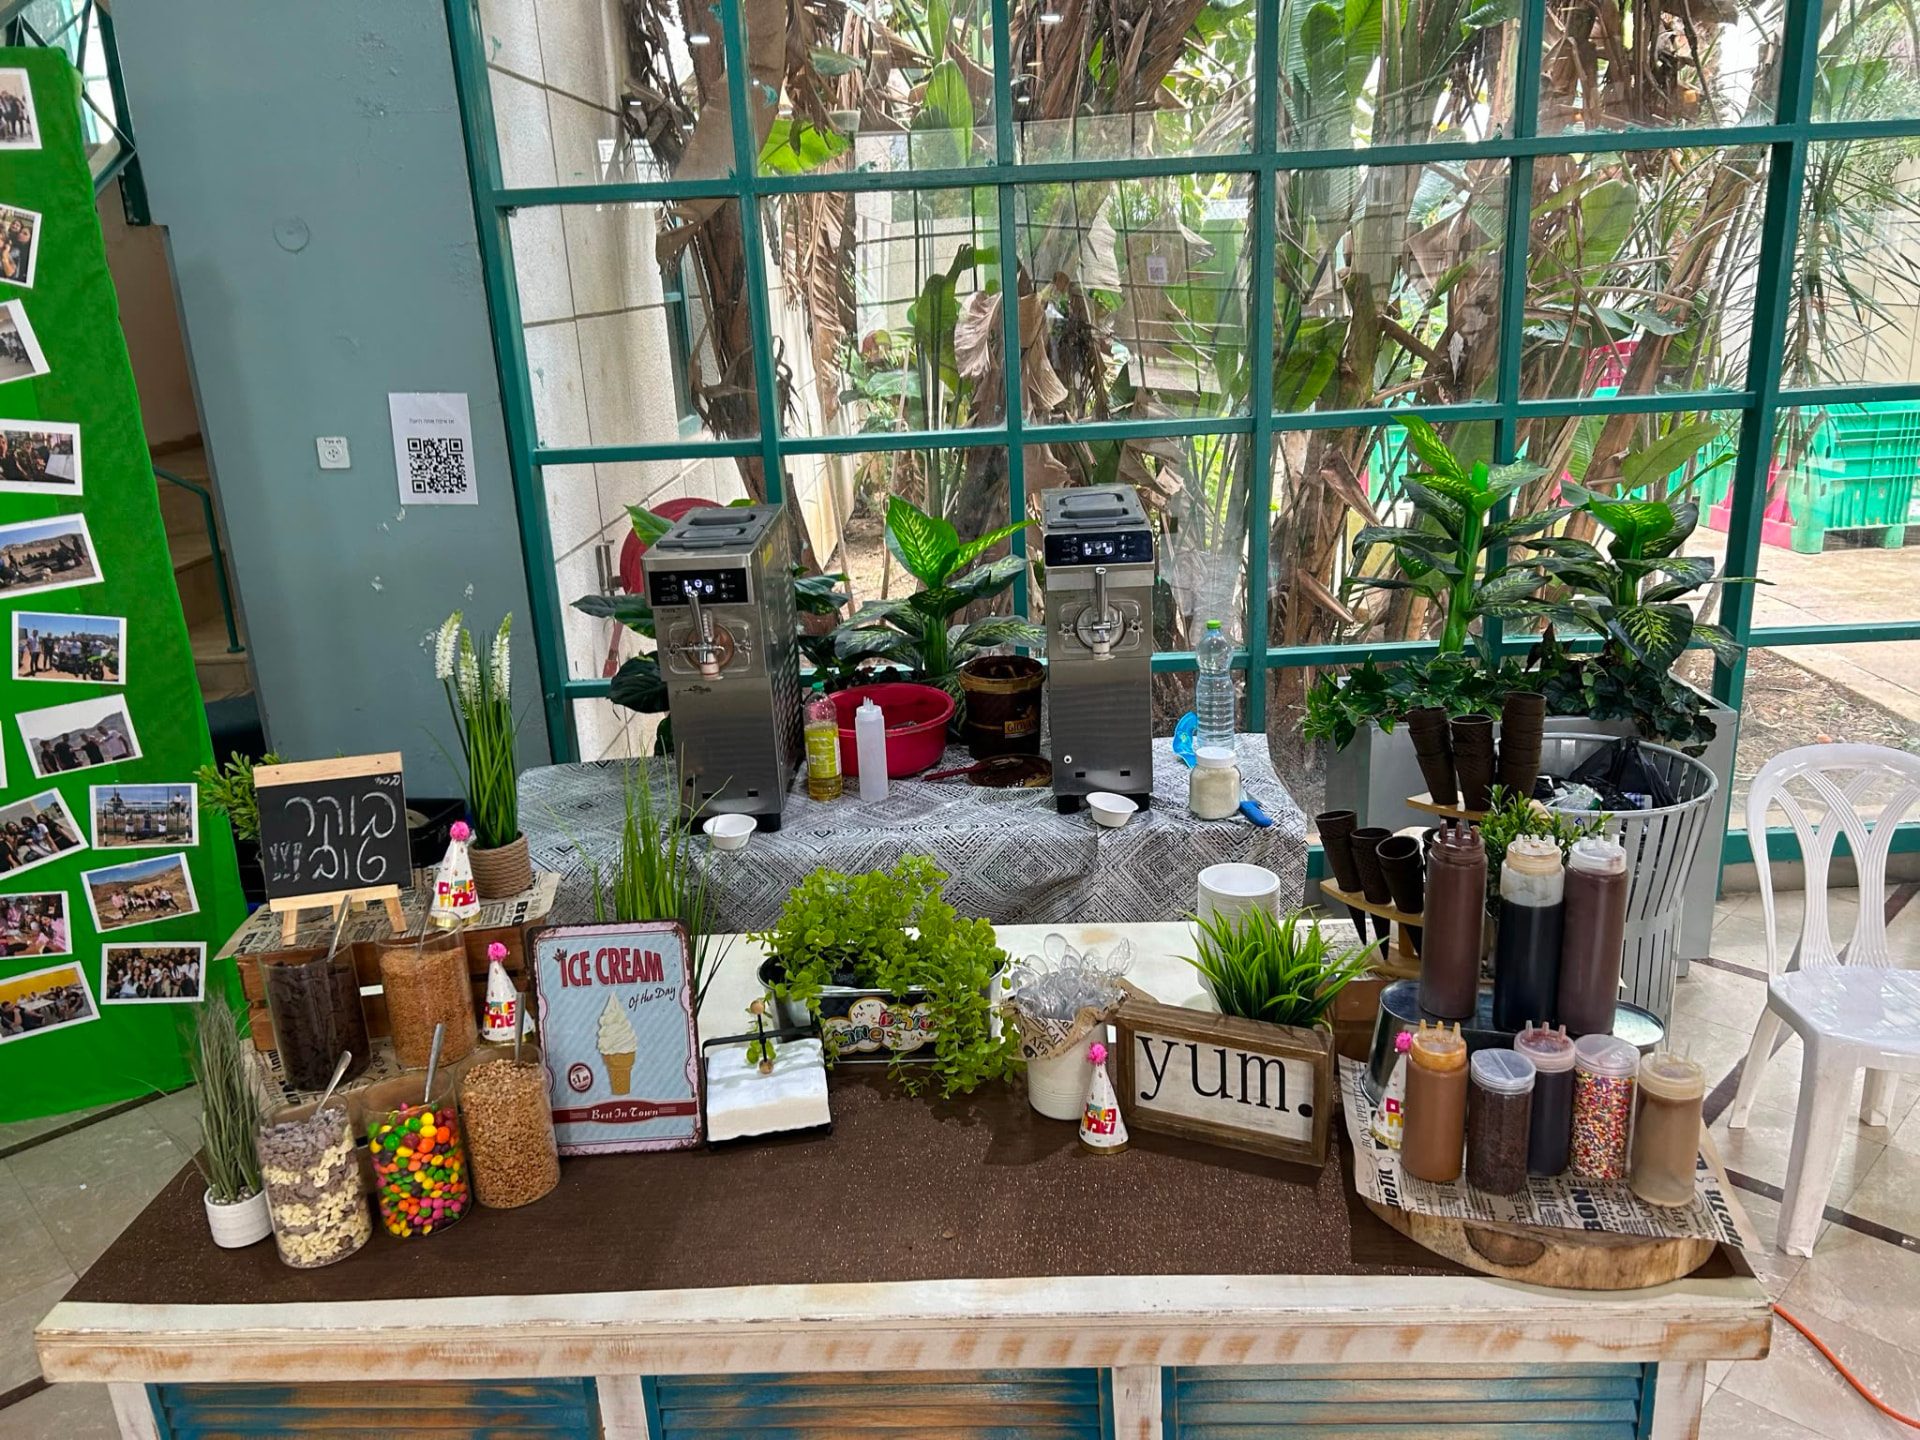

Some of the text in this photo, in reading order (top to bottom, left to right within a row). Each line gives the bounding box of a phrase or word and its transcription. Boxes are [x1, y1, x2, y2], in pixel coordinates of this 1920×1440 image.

[285, 791, 396, 850] בוקר
[309, 836, 387, 883] טוב
[560, 947, 664, 988] ICE CREAM
[655, 985, 677, 1002] Day
[1135, 1035, 1313, 1119] yum.
[629, 1106, 659, 1120] Town
